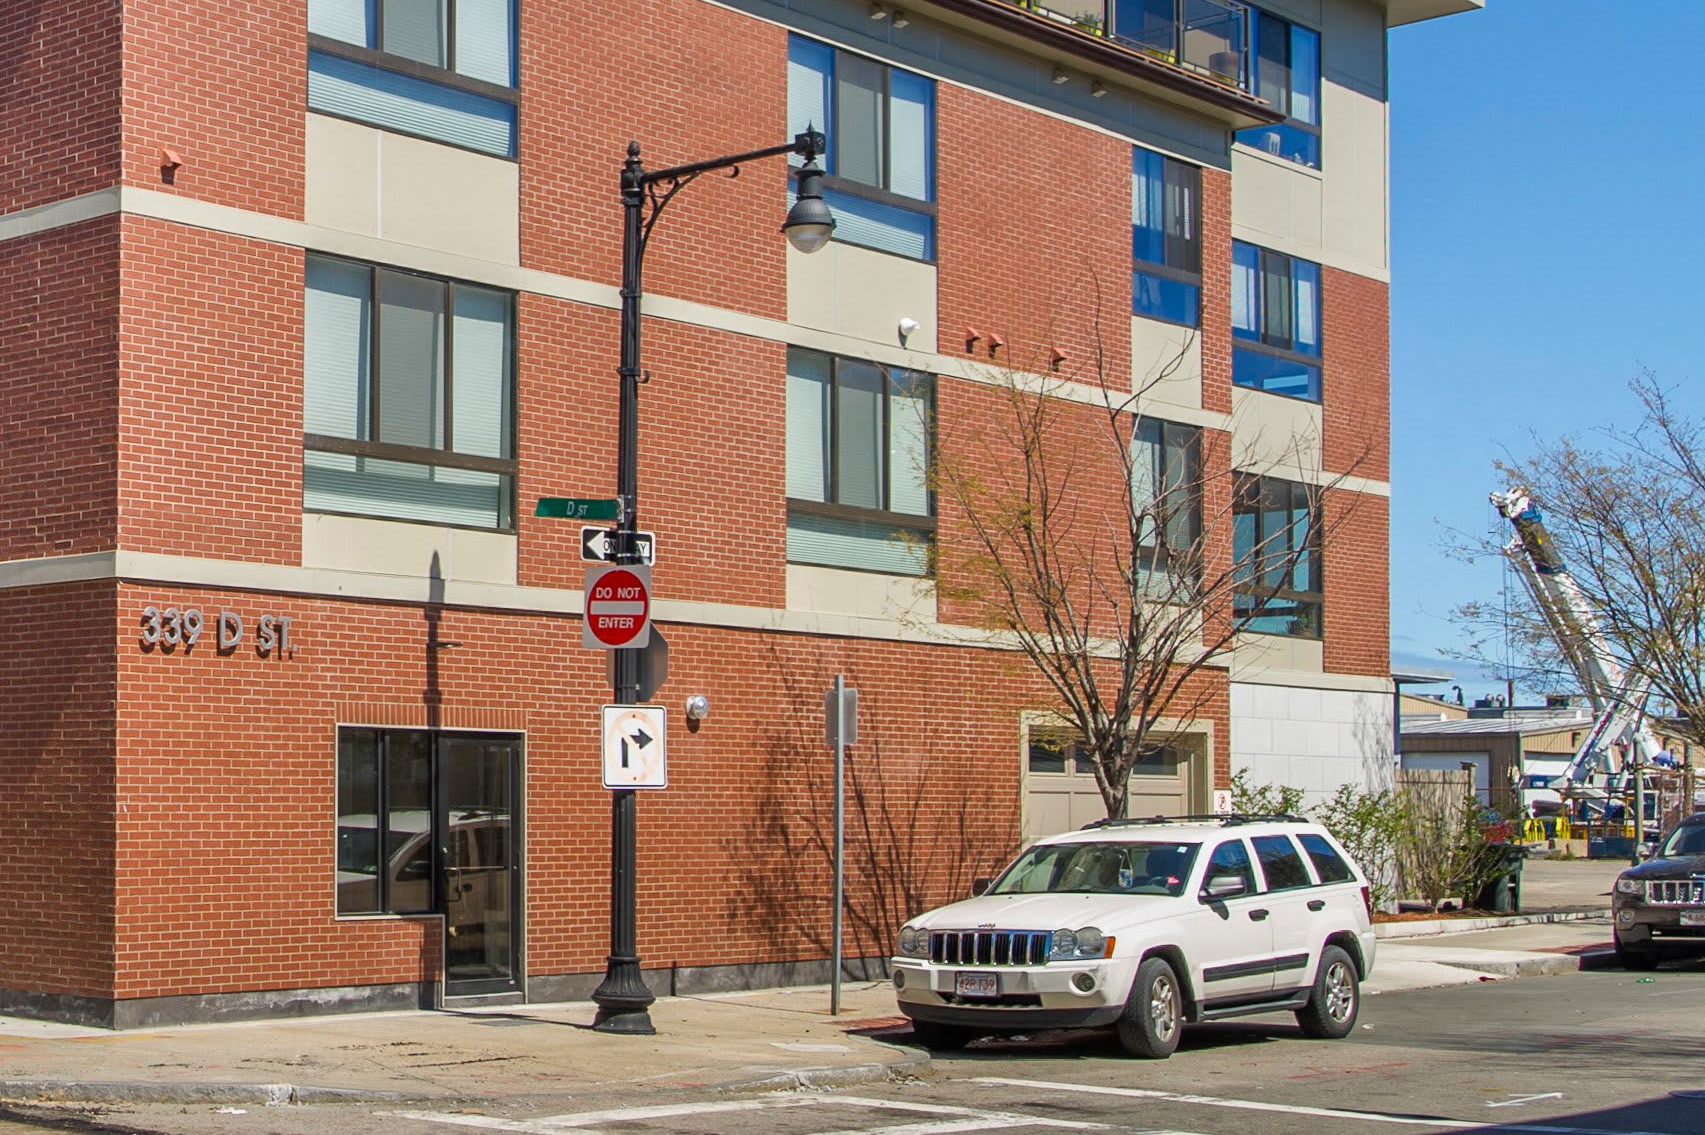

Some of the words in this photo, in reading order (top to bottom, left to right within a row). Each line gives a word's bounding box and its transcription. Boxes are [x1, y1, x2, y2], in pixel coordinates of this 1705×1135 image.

[566, 501, 575, 516] D
[577, 505, 589, 516] ST
[596, 587, 613, 599] DO
[617, 587, 641, 599] NOT
[143, 606, 204, 644] 339
[220, 611, 244, 647] D
[259, 614, 298, 652] ST.
[598, 617, 634, 629] ENTER
